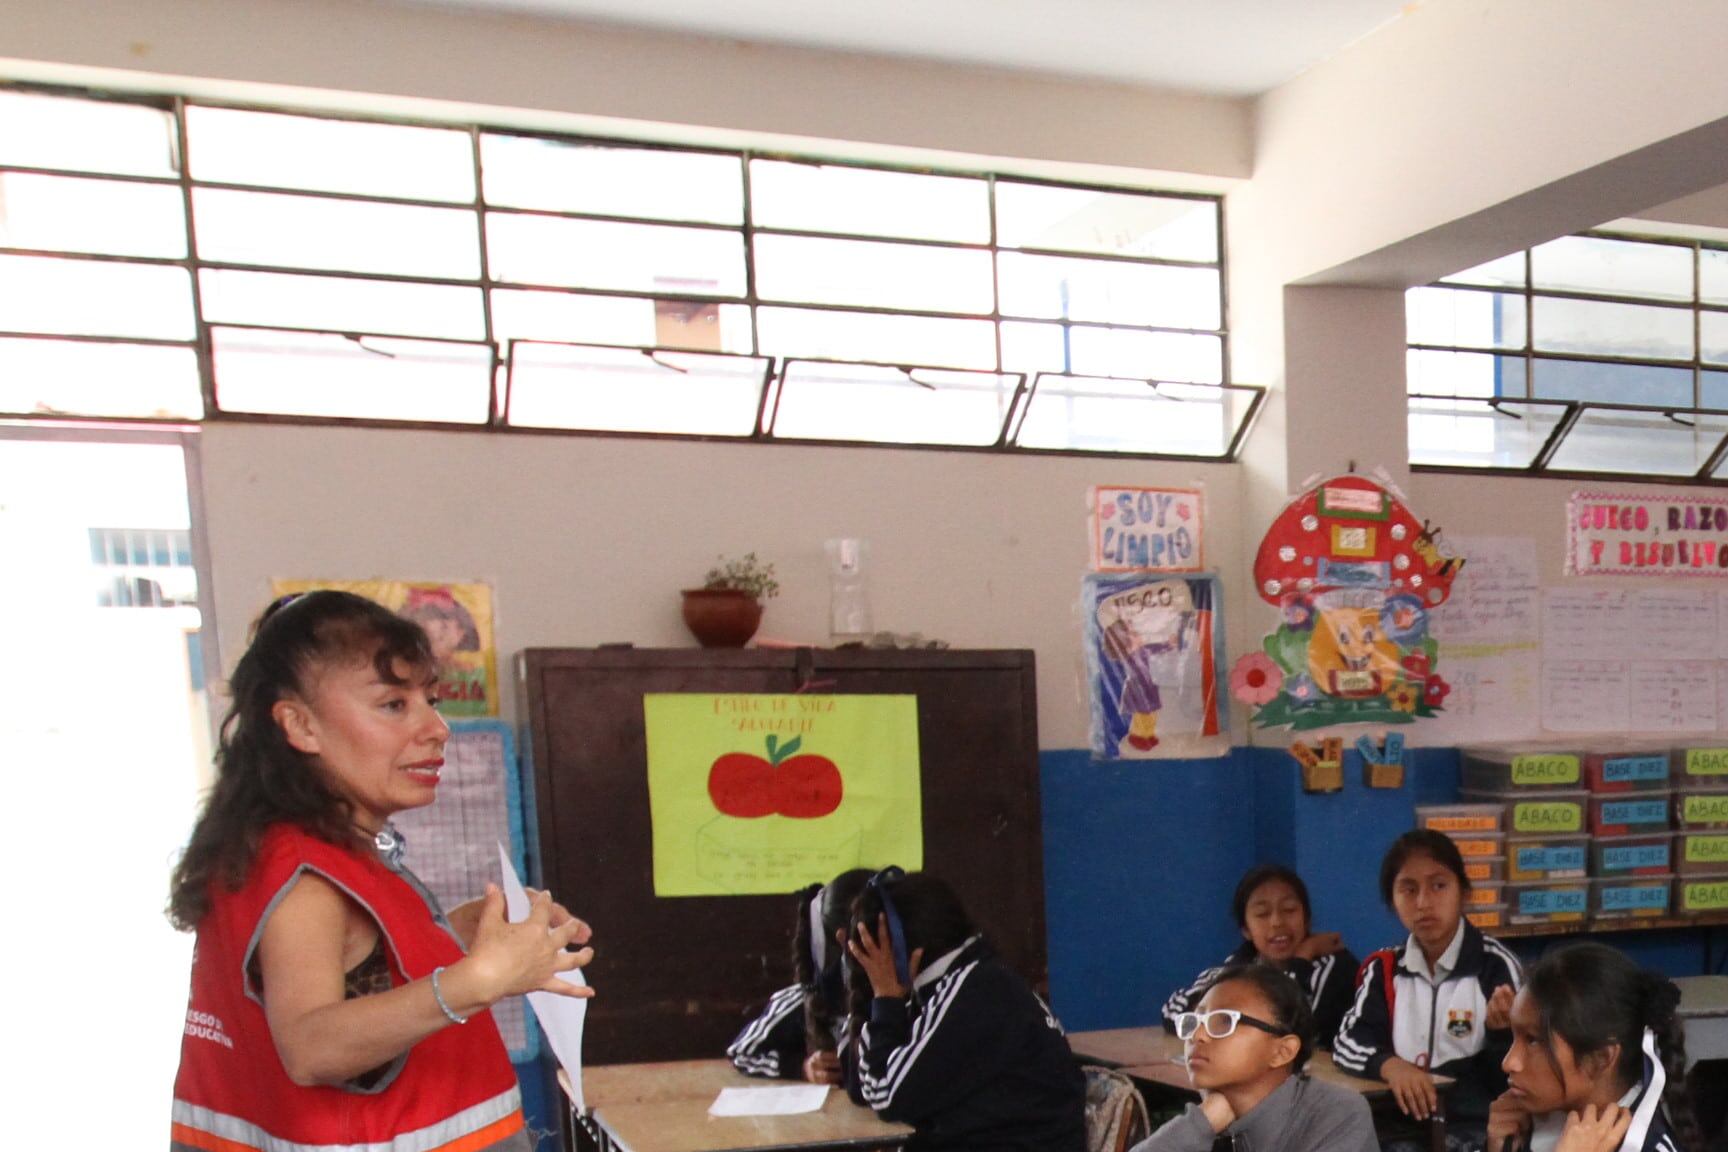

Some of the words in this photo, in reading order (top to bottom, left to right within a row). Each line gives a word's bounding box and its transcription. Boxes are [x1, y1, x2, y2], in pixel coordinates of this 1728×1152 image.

[1116, 491, 1173, 528] SOY
[1103, 527, 1192, 568] LIMPIO
[1590, 540, 1605, 566] Y
[1606, 763, 1632, 777] BASE
[1639, 761, 1663, 774] DIEZ
[1604, 807, 1630, 821] BASE
[1639, 850, 1664, 863] DIEZ
[1556, 893, 1581, 908] DIEZ
[1640, 888, 1663, 901] DIEZ
